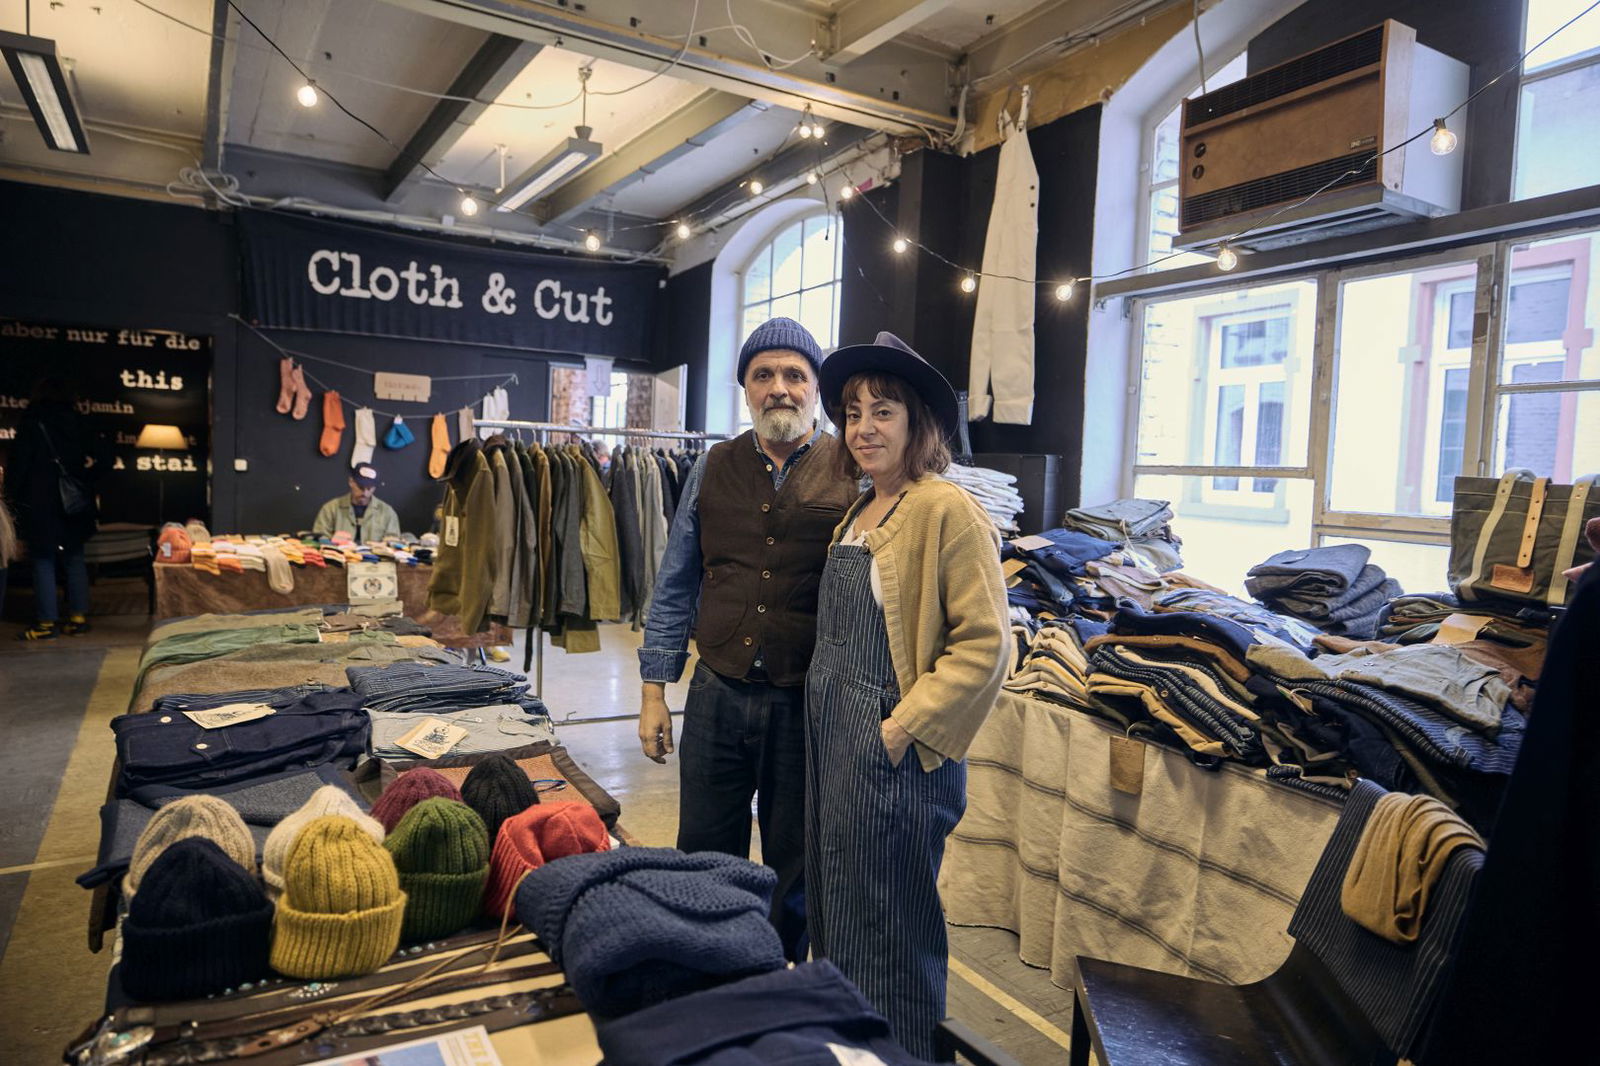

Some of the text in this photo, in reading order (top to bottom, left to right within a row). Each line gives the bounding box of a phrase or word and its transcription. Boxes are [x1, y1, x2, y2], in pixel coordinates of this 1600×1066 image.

[307, 249, 614, 326] Cloth & Cut
[1, 320, 200, 350] aber nur für die
[120, 369, 183, 390] this
[136, 455, 197, 471] stai
